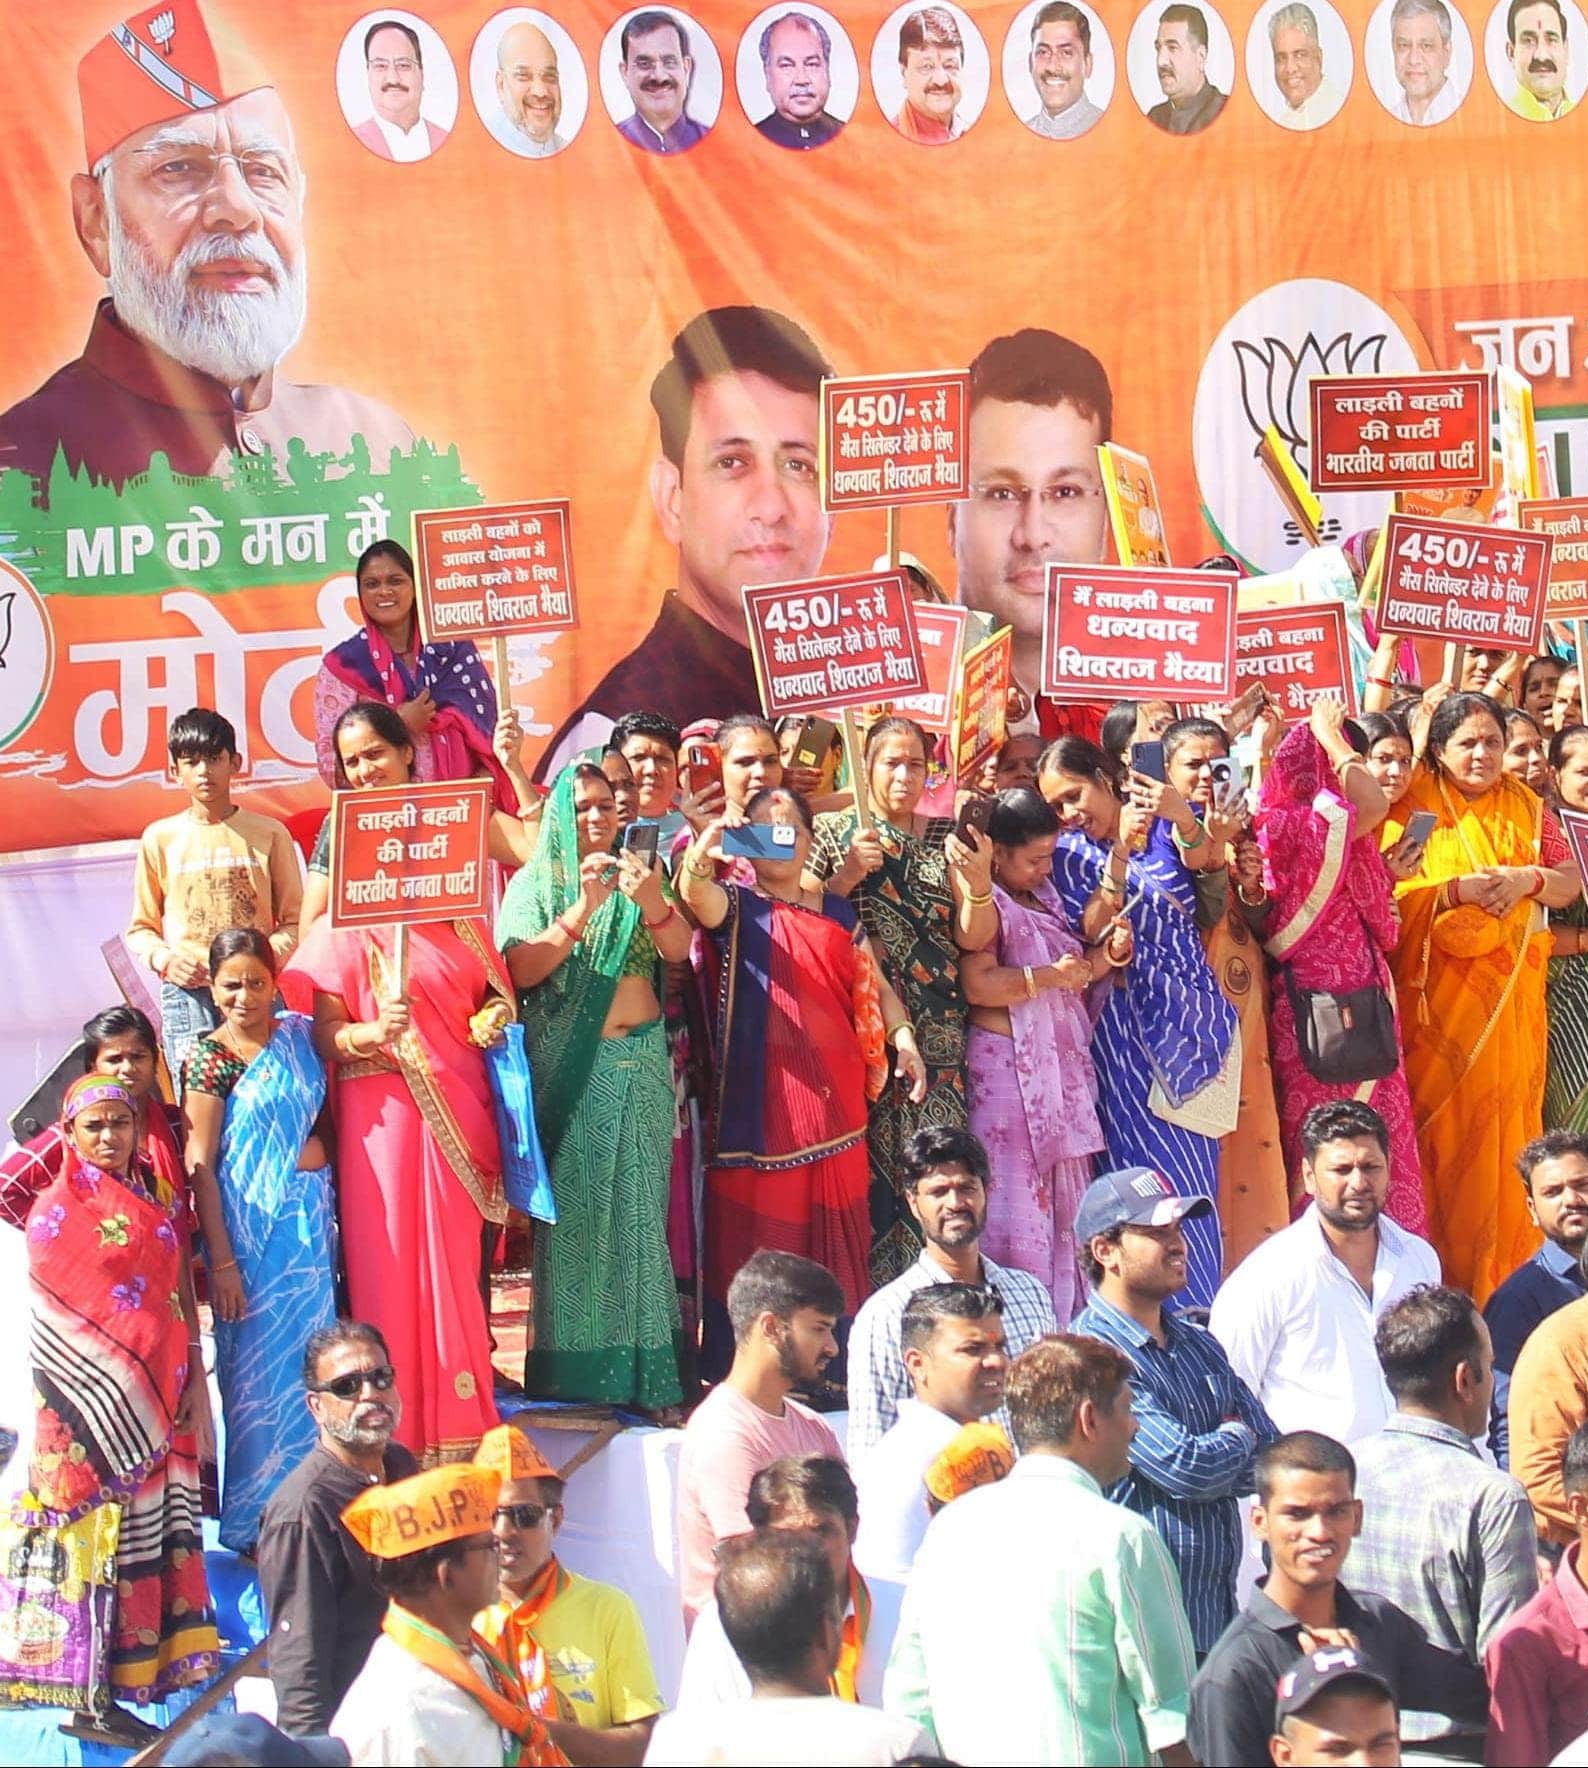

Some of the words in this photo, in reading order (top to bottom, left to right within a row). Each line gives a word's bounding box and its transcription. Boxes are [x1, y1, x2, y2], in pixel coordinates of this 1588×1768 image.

[1454, 315, 1574, 380] जन
[836, 393, 915, 428] 450/-
[1409, 388, 1464, 412] बहनों
[1359, 420, 1390, 441] की
[1397, 418, 1441, 439] पार्टी
[1326, 446, 1384, 474] भारतीय
[1389, 450, 1435, 471] जनता
[1440, 442, 1474, 469] पार्टी
[66, 524, 154, 578] MP
[165, 506, 224, 571] के
[240, 513, 329, 566] मन
[1398, 532, 1489, 569] 450/-
[765, 593, 853, 633] 450/-
[1163, 596, 1214, 613] बहना
[1088, 615, 1199, 645] धन्यवाद
[1059, 646, 1156, 681] शिवराज
[1237, 652, 1314, 676] न्यवाद
[422, 799, 470, 826] बहनों
[377, 838, 404, 863] की
[409, 834, 449, 860] पार्टी
[346, 869, 397, 904] भारतीय
[401, 873, 442, 899] जनता
[445, 861, 476, 895] पार्टी
[395, 1488, 480, 1540] B.J.P.
